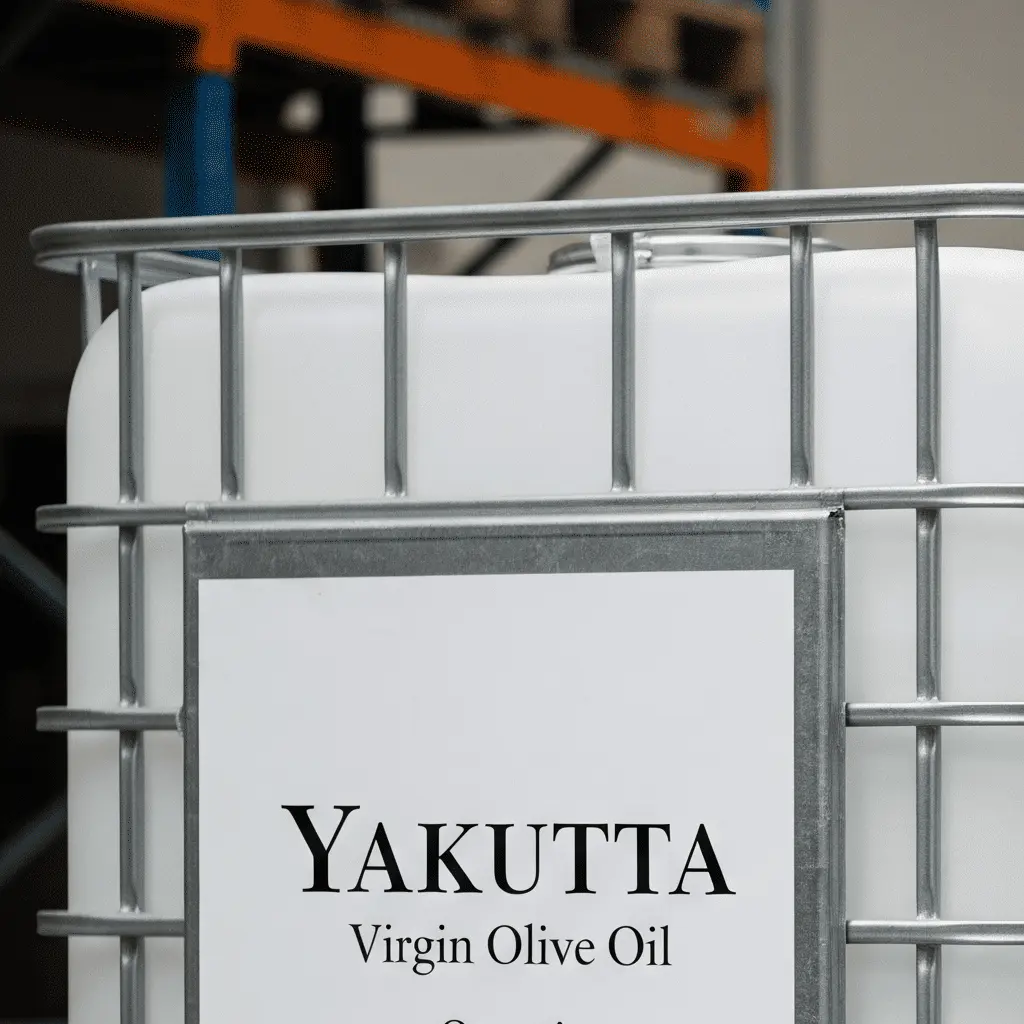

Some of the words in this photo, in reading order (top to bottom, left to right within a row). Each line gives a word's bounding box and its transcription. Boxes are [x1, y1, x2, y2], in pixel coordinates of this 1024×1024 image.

[281, 804, 737, 896] YAKUTTA
[349, 923, 474, 976] Virgin
[487, 922, 595, 966] Olive
[608, 924, 672, 967] Oil
